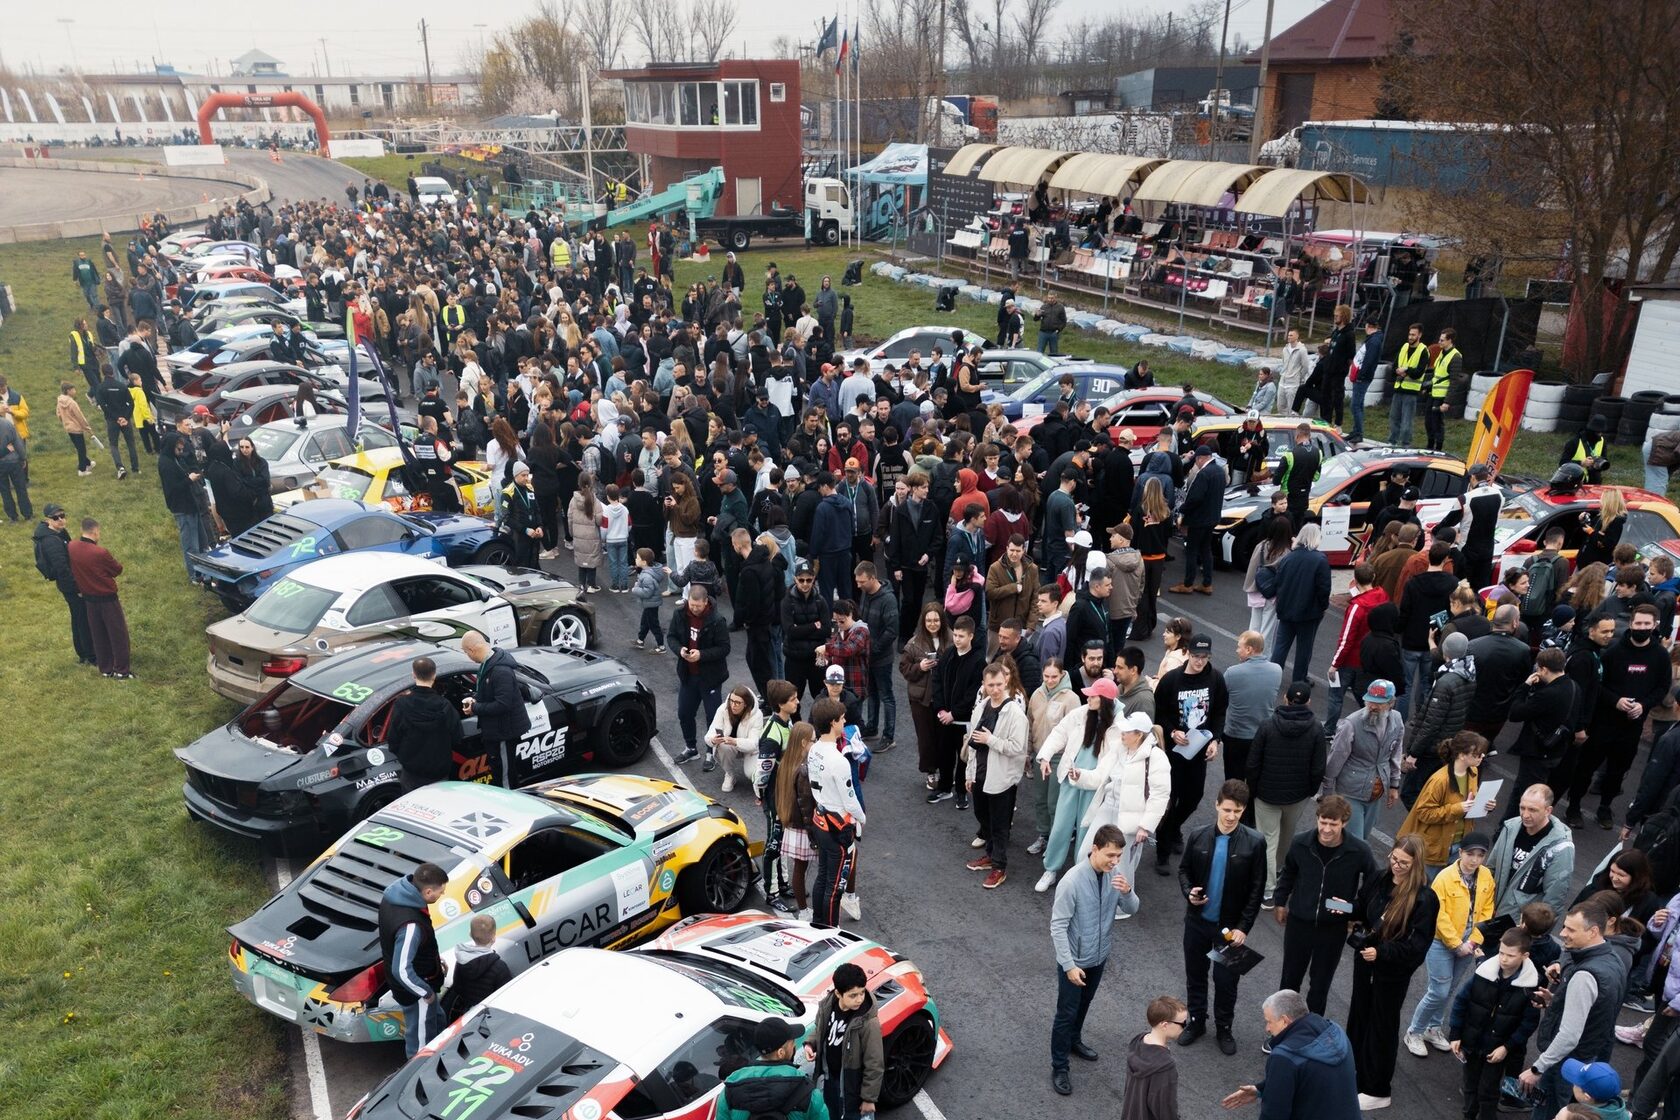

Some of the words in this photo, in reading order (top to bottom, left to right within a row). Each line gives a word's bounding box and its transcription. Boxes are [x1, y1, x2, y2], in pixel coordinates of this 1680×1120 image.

[1092, 378, 1111, 393] 90
[333, 682, 374, 702] 63
[516, 726, 569, 760] RACE
[532, 753, 566, 770] MOTORSPORT
[296, 767, 339, 789] CLUBTURBO
[355, 827, 404, 847] 22
[524, 903, 612, 964] LECAR
[487, 1042, 513, 1059] YUKA
[510, 1053, 534, 1067] ADV
[451, 1056, 515, 1097] 22
